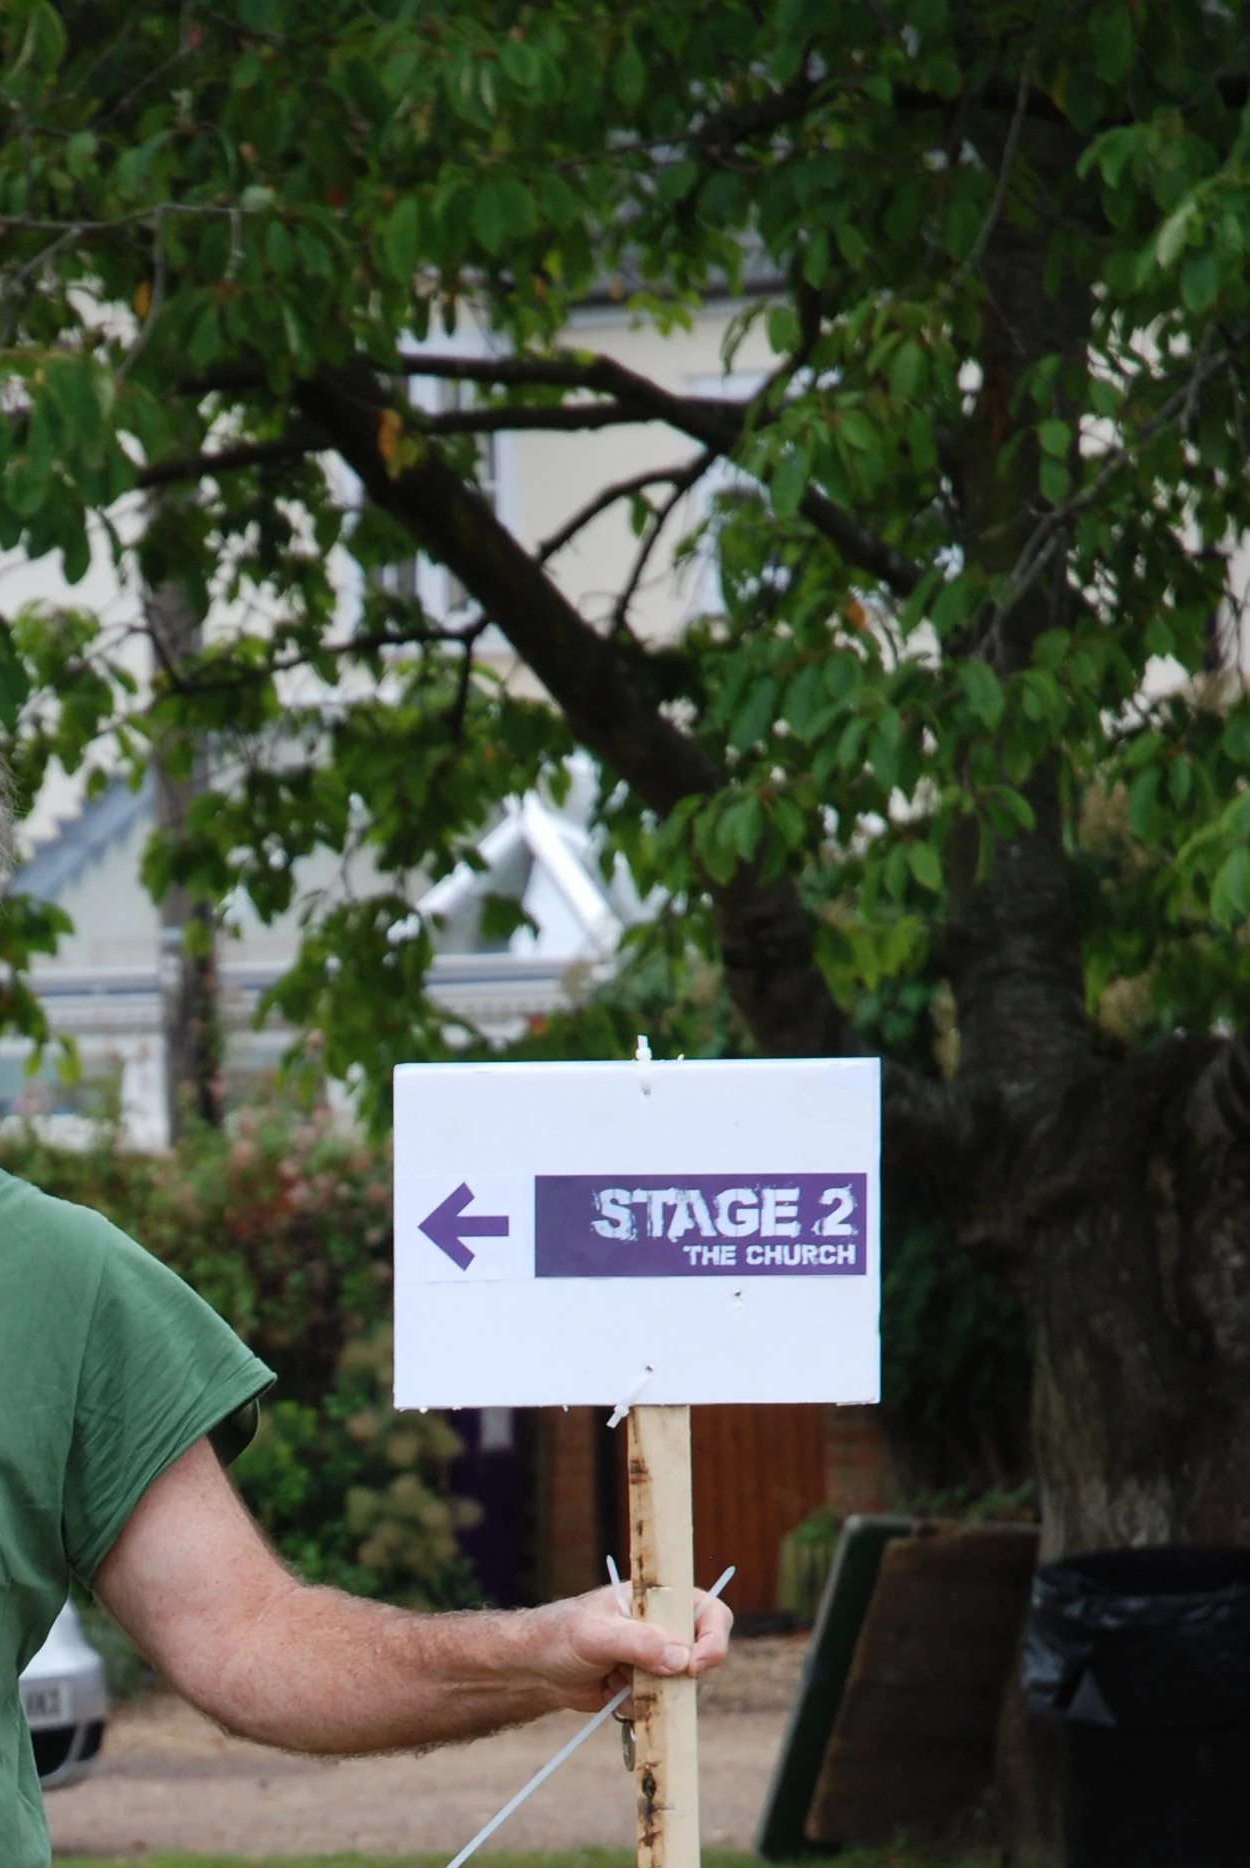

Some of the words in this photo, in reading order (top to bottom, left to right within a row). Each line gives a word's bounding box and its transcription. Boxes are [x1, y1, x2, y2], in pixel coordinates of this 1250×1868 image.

[591, 1187, 801, 1242] STAGE
[812, 1183, 858, 1237] 2
[683, 1245, 736, 1266] THE
[746, 1244, 855, 1266] CHURCH
